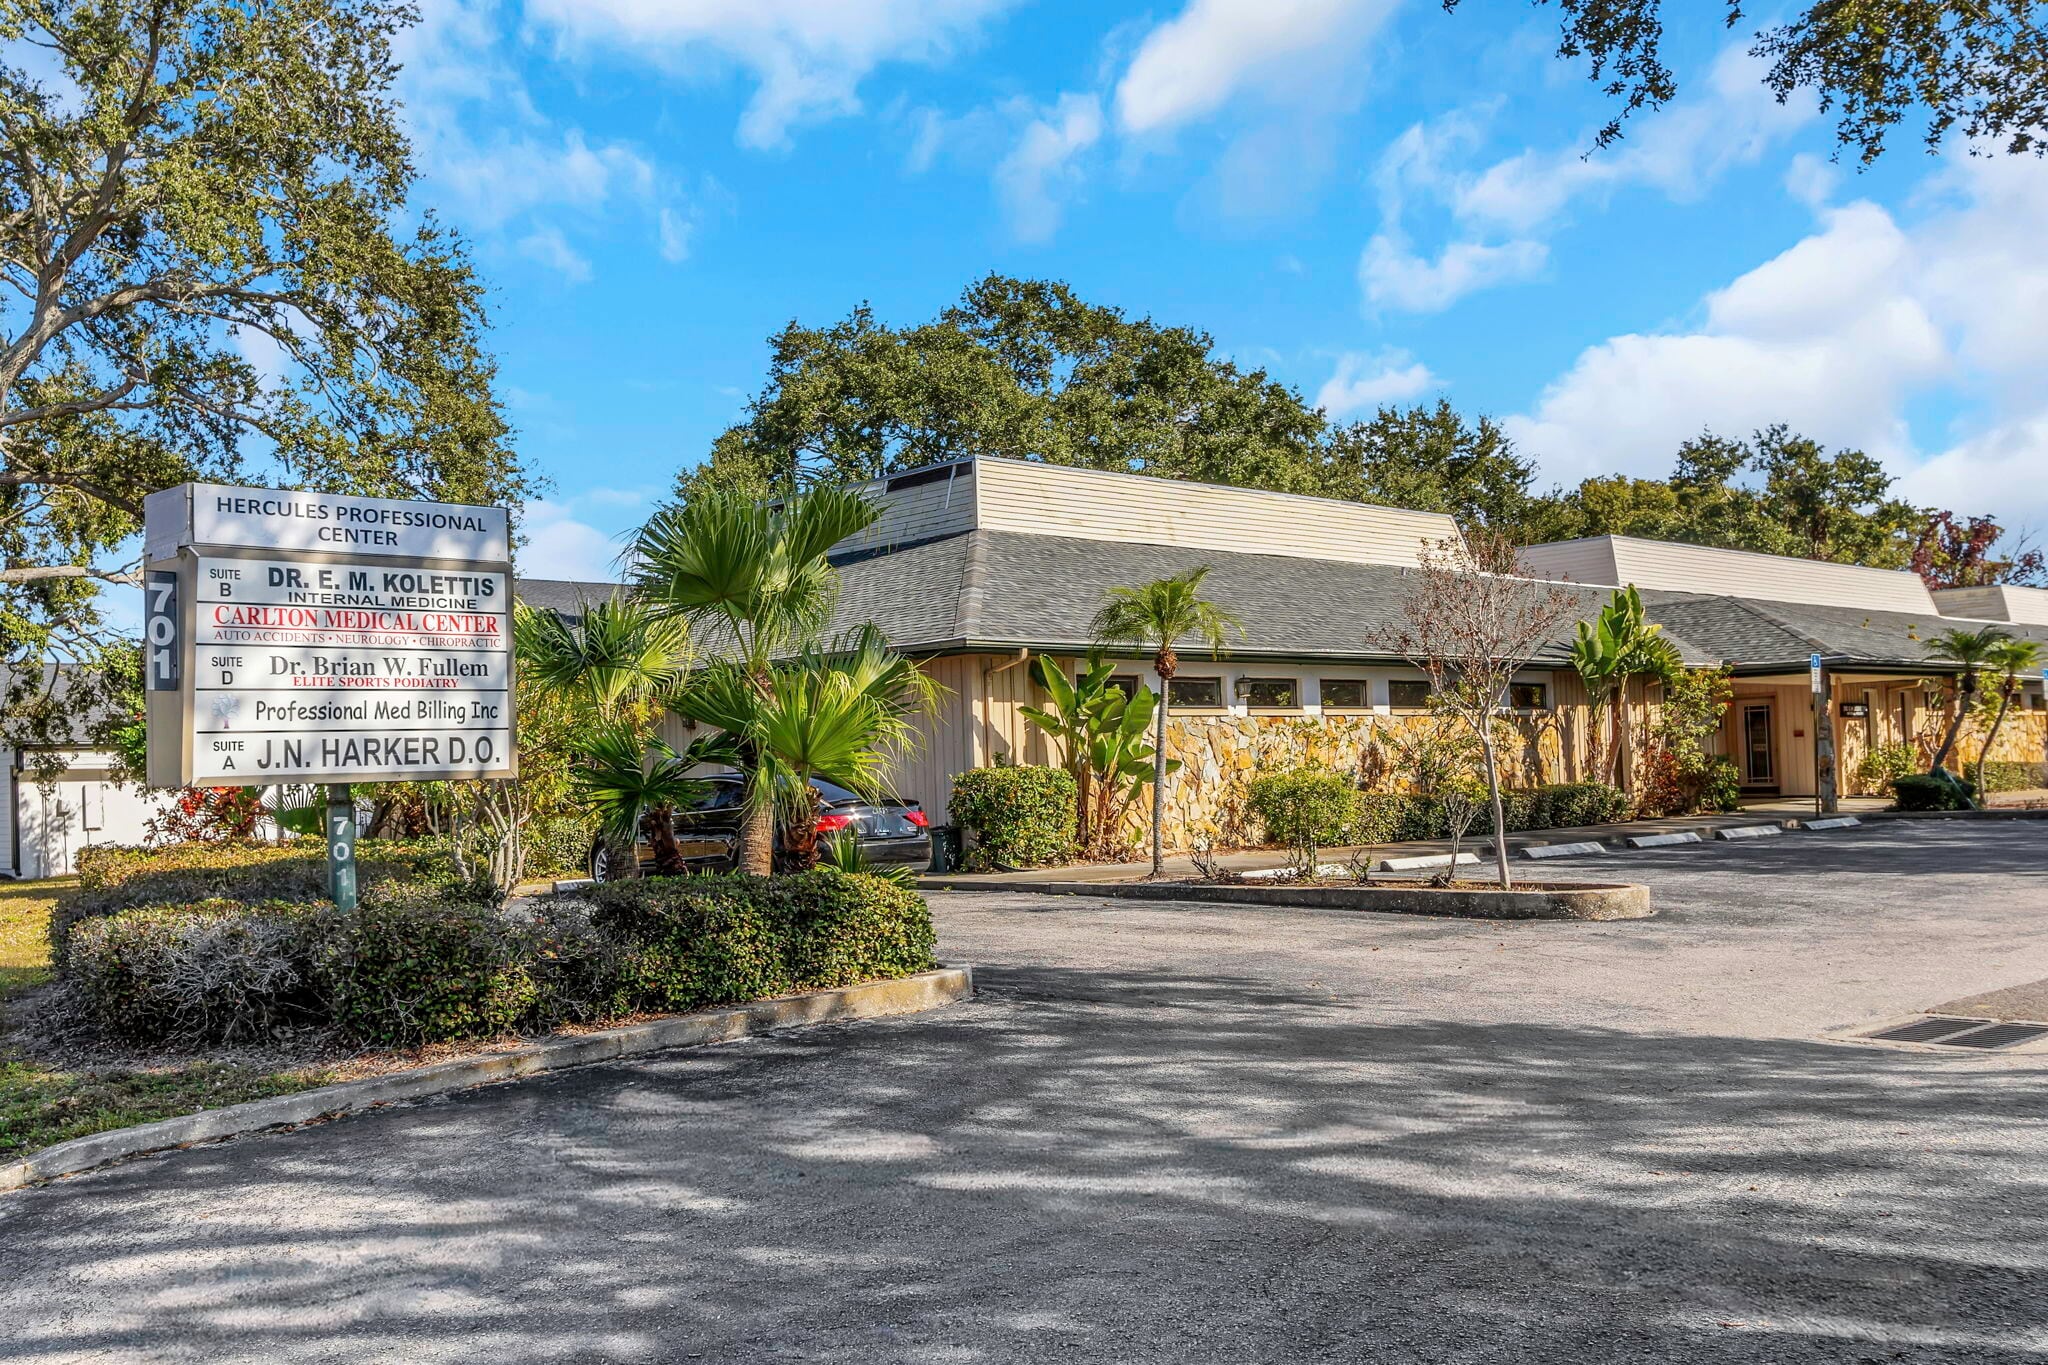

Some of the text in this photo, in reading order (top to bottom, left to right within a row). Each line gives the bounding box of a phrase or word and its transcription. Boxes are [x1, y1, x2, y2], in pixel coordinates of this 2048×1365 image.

[216, 497, 487, 532] HERCULES PROFESSIONAL
[318, 527, 398, 546] CENTER
[209, 569, 241, 580] SUITE
[268, 568, 494, 597] DR. E. M. KOLETTIS
[220, 583, 232, 597] B
[288, 592, 477, 609] INTERNAL MEDICINE
[215, 606, 498, 633] CARLTON MEDICAL CENTER
[148, 583, 176, 679] 701
[214, 630, 501, 648] AUTO ACCIDENTS NEUROLOGY CHIROPRACTIC
[212, 657, 242, 667] SUITE
[270, 656, 488, 677] Dr. Brian W. Fullem
[222, 671, 233, 685] D
[293, 677, 459, 688] ELITE SPORTS PODIATRY
[256, 700, 498, 723] Professional Med Billing Inc
[213, 741, 244, 752] SUITE
[257, 737, 500, 768] J.N. HARKER D.O.
[222, 756, 235, 769] A
